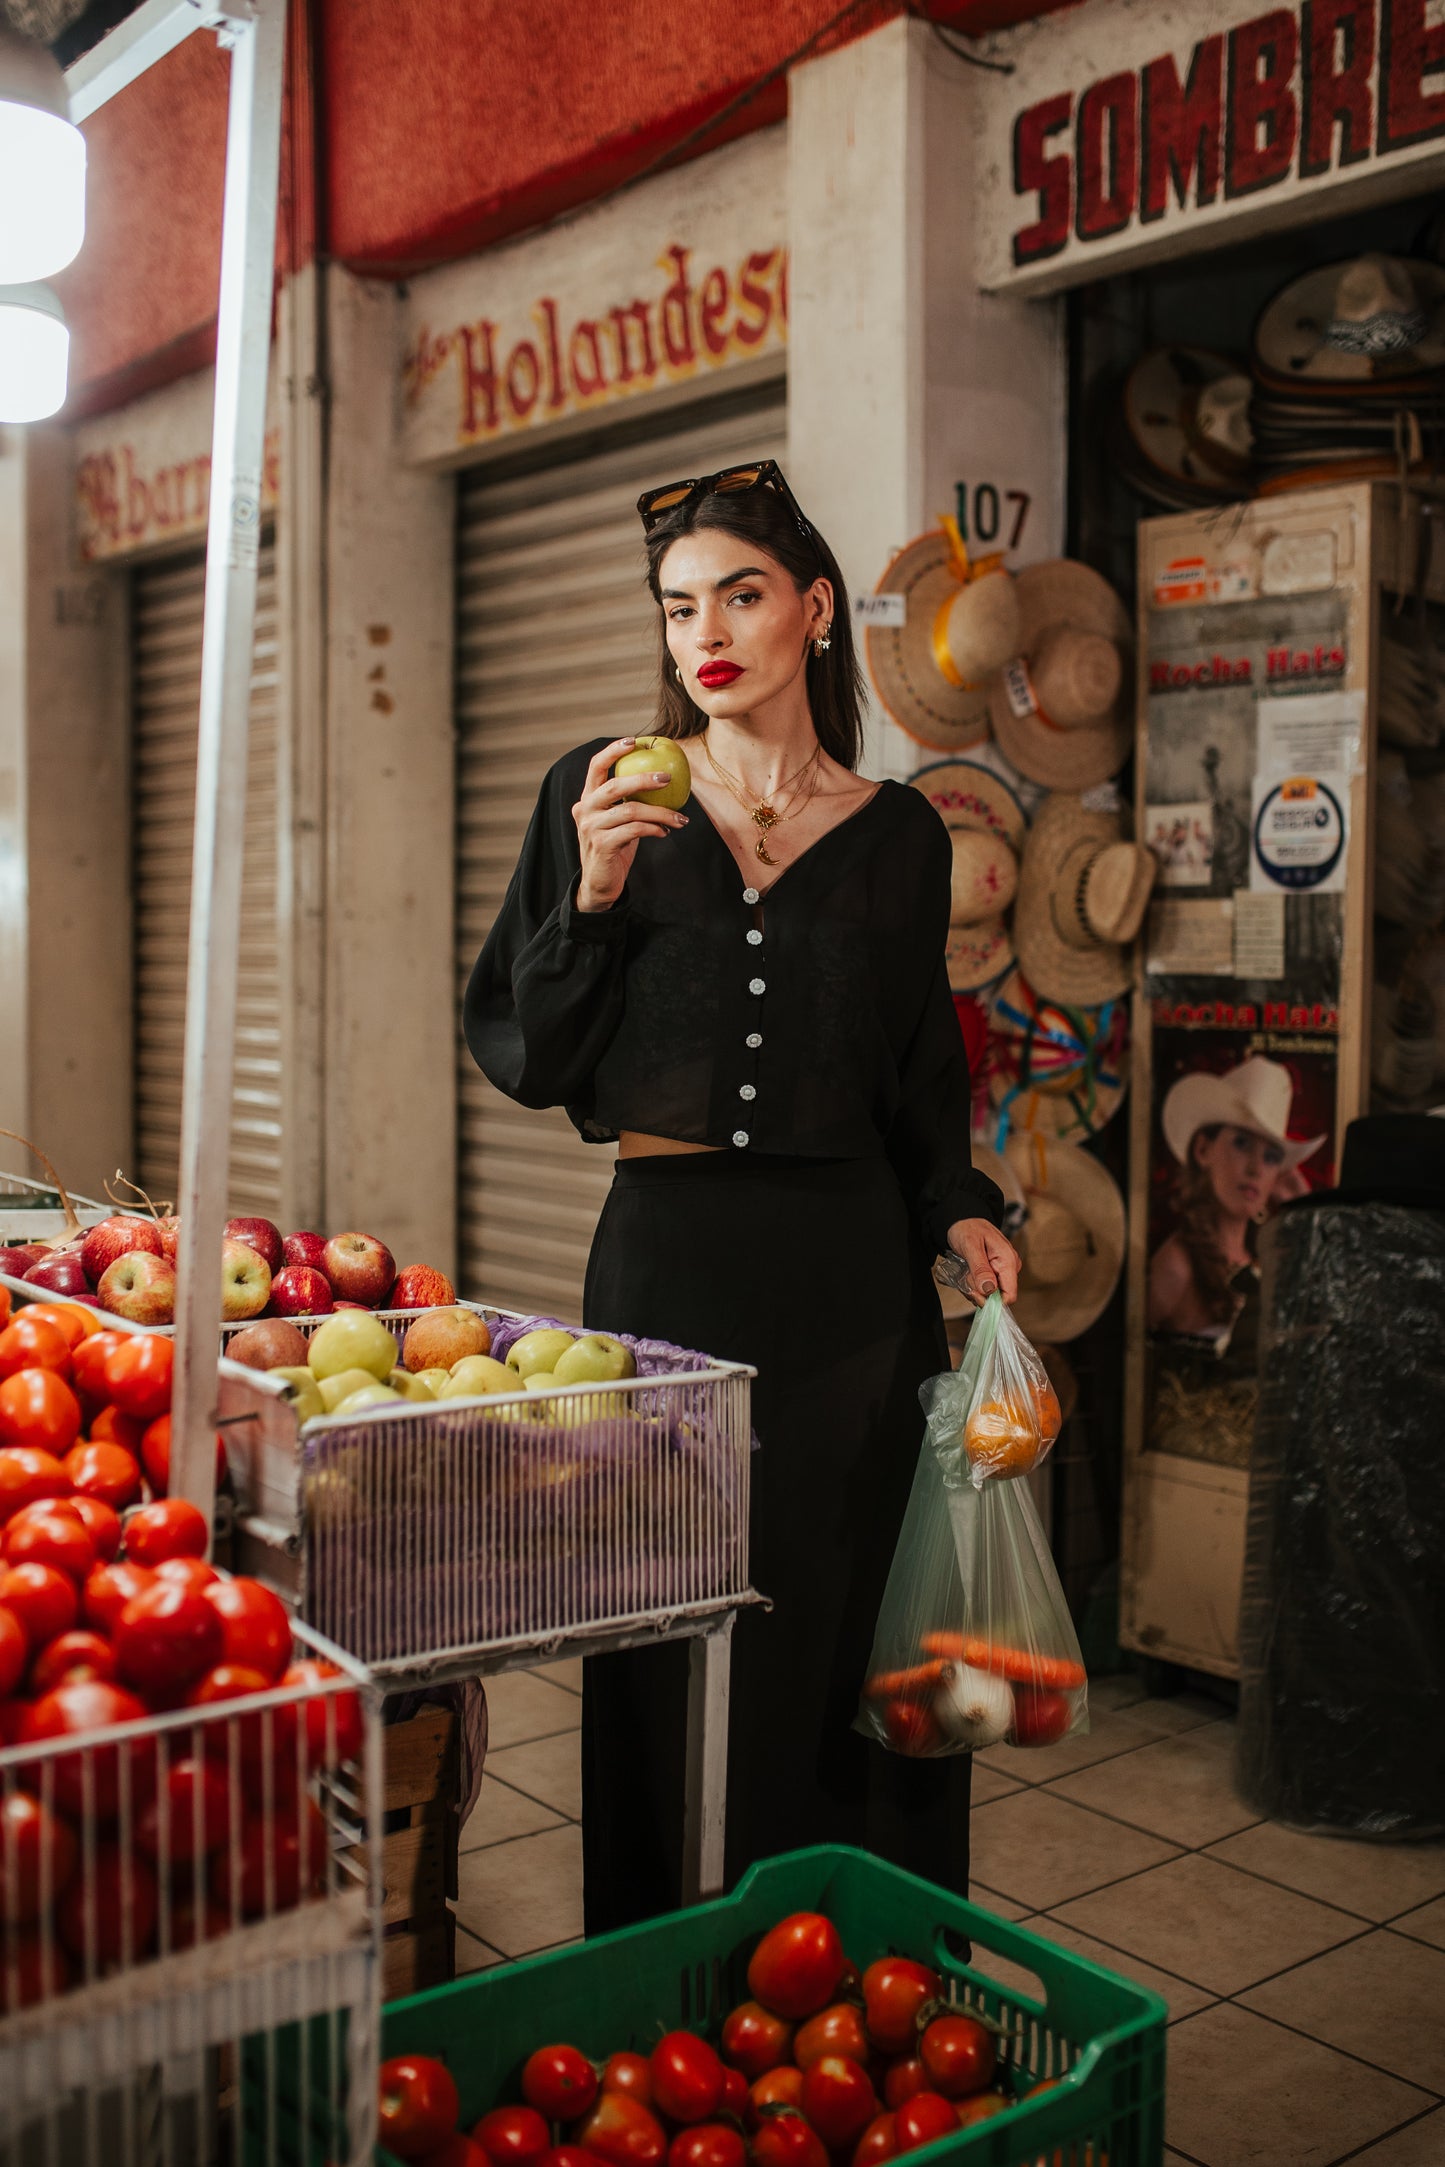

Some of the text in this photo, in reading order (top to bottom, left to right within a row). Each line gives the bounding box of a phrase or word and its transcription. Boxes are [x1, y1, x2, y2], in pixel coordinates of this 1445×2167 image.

[456, 243, 788, 444] Holandes
[954, 479, 1031, 550] 107
[1266, 642, 1346, 681] Hats
